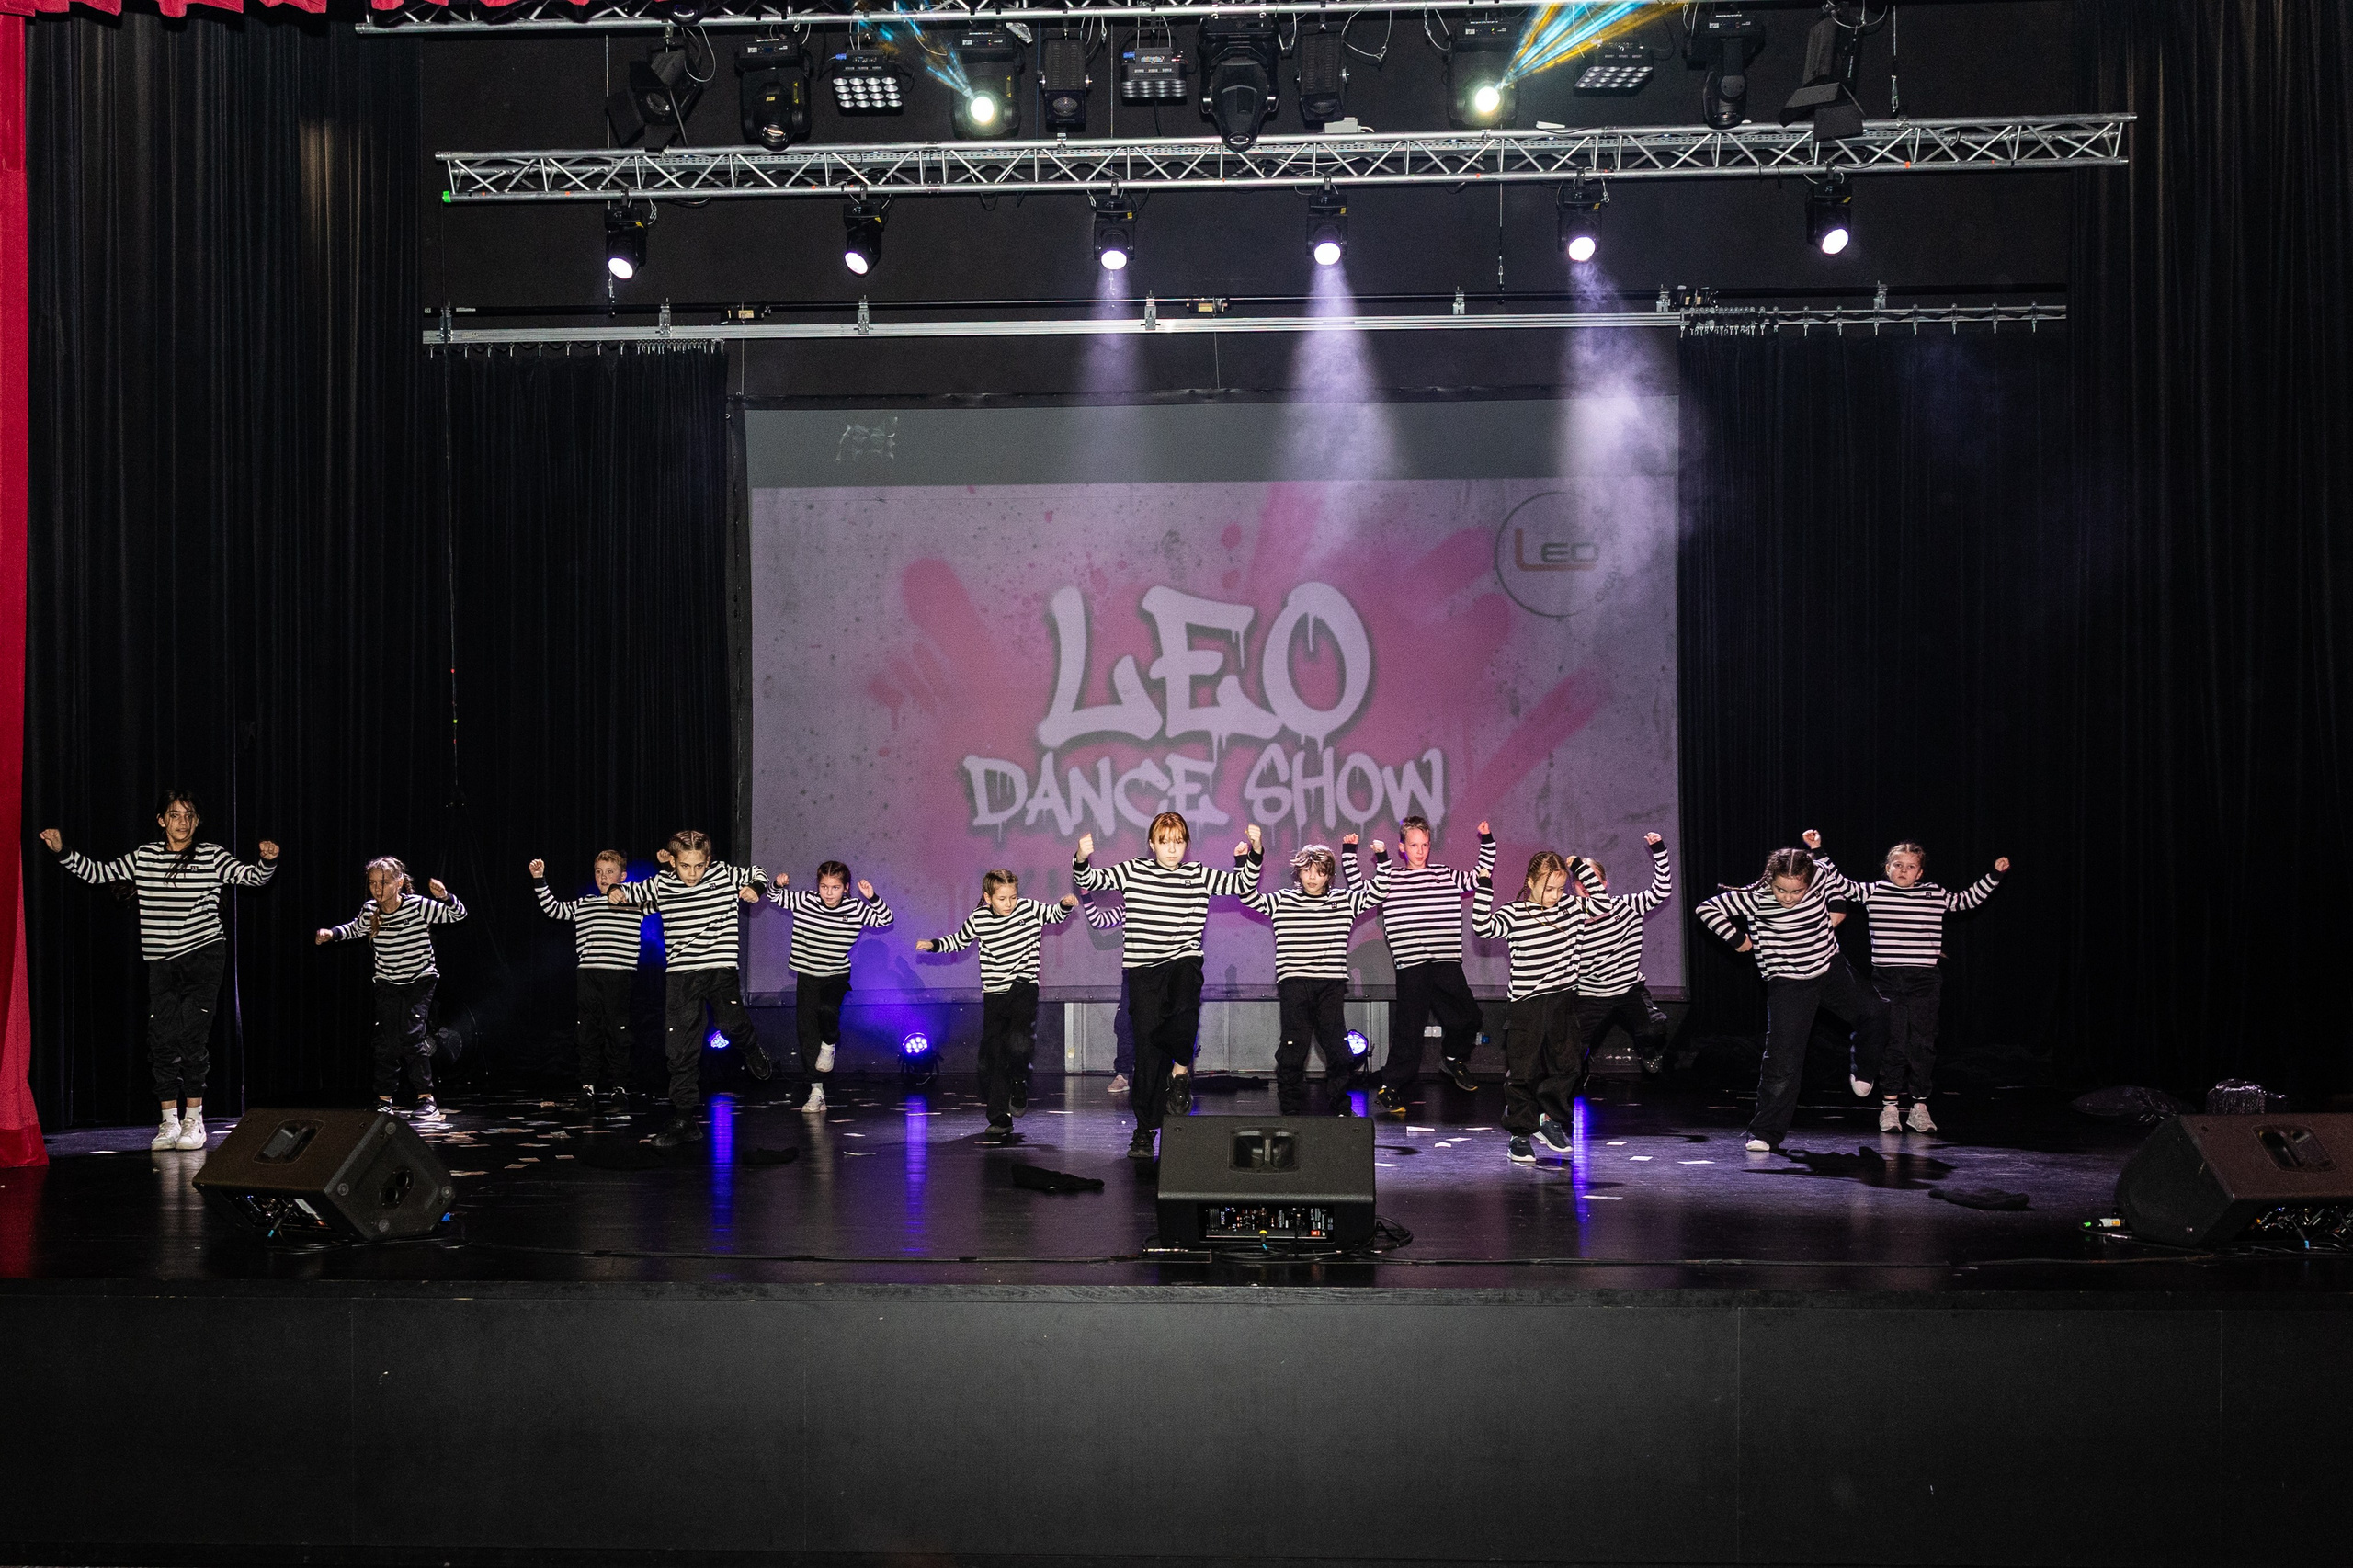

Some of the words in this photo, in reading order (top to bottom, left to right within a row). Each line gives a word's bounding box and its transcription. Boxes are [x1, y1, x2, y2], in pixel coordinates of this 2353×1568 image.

[1038, 581, 1371, 750] LEO
[962, 751, 1230, 837] DANCE
[1244, 743, 1446, 837] SHOW
